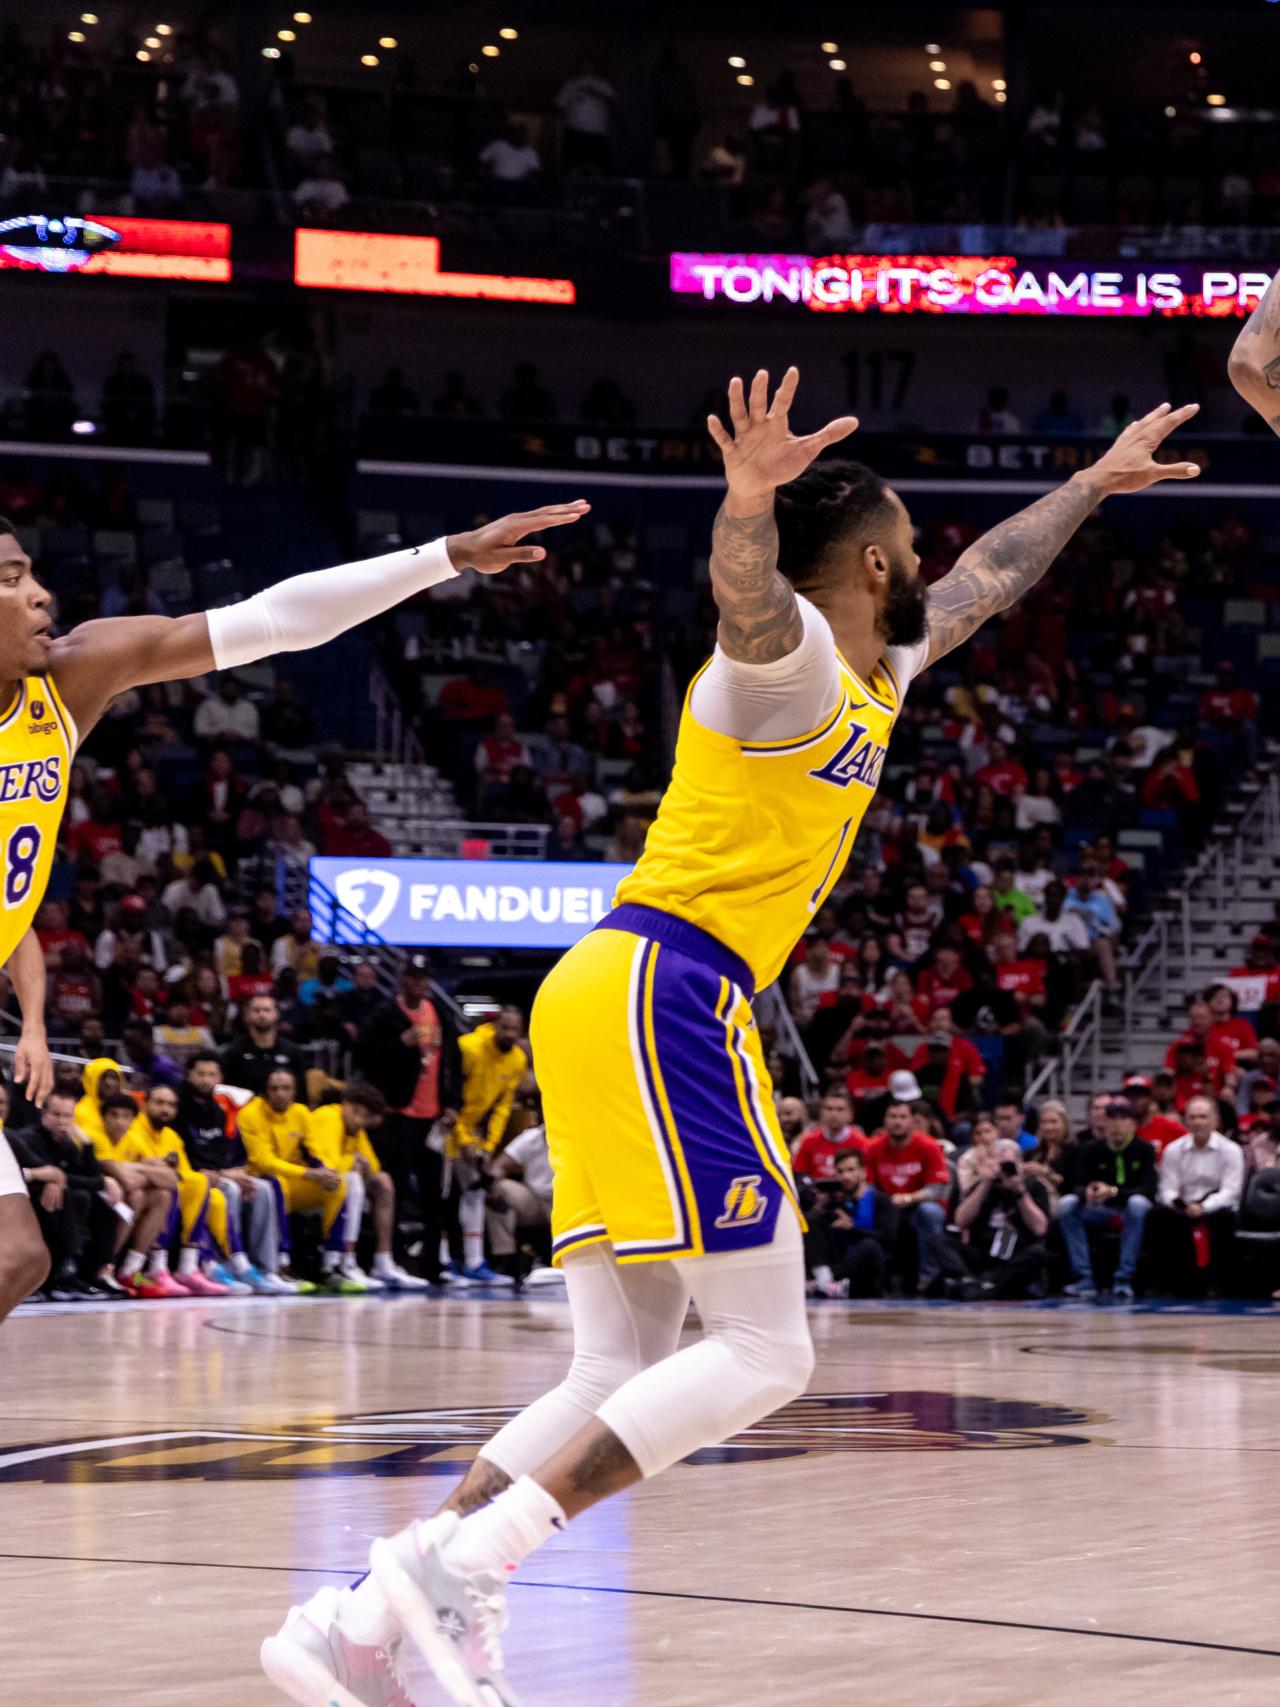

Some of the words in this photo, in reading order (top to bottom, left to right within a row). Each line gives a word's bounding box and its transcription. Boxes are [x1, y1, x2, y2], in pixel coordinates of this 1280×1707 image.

[974, 269, 1124, 307] GAME
[1136, 273, 1183, 308] IS
[841, 349, 917, 409] 117
[4, 822, 43, 912] 8
[409, 883, 612, 923] FANDUEL
